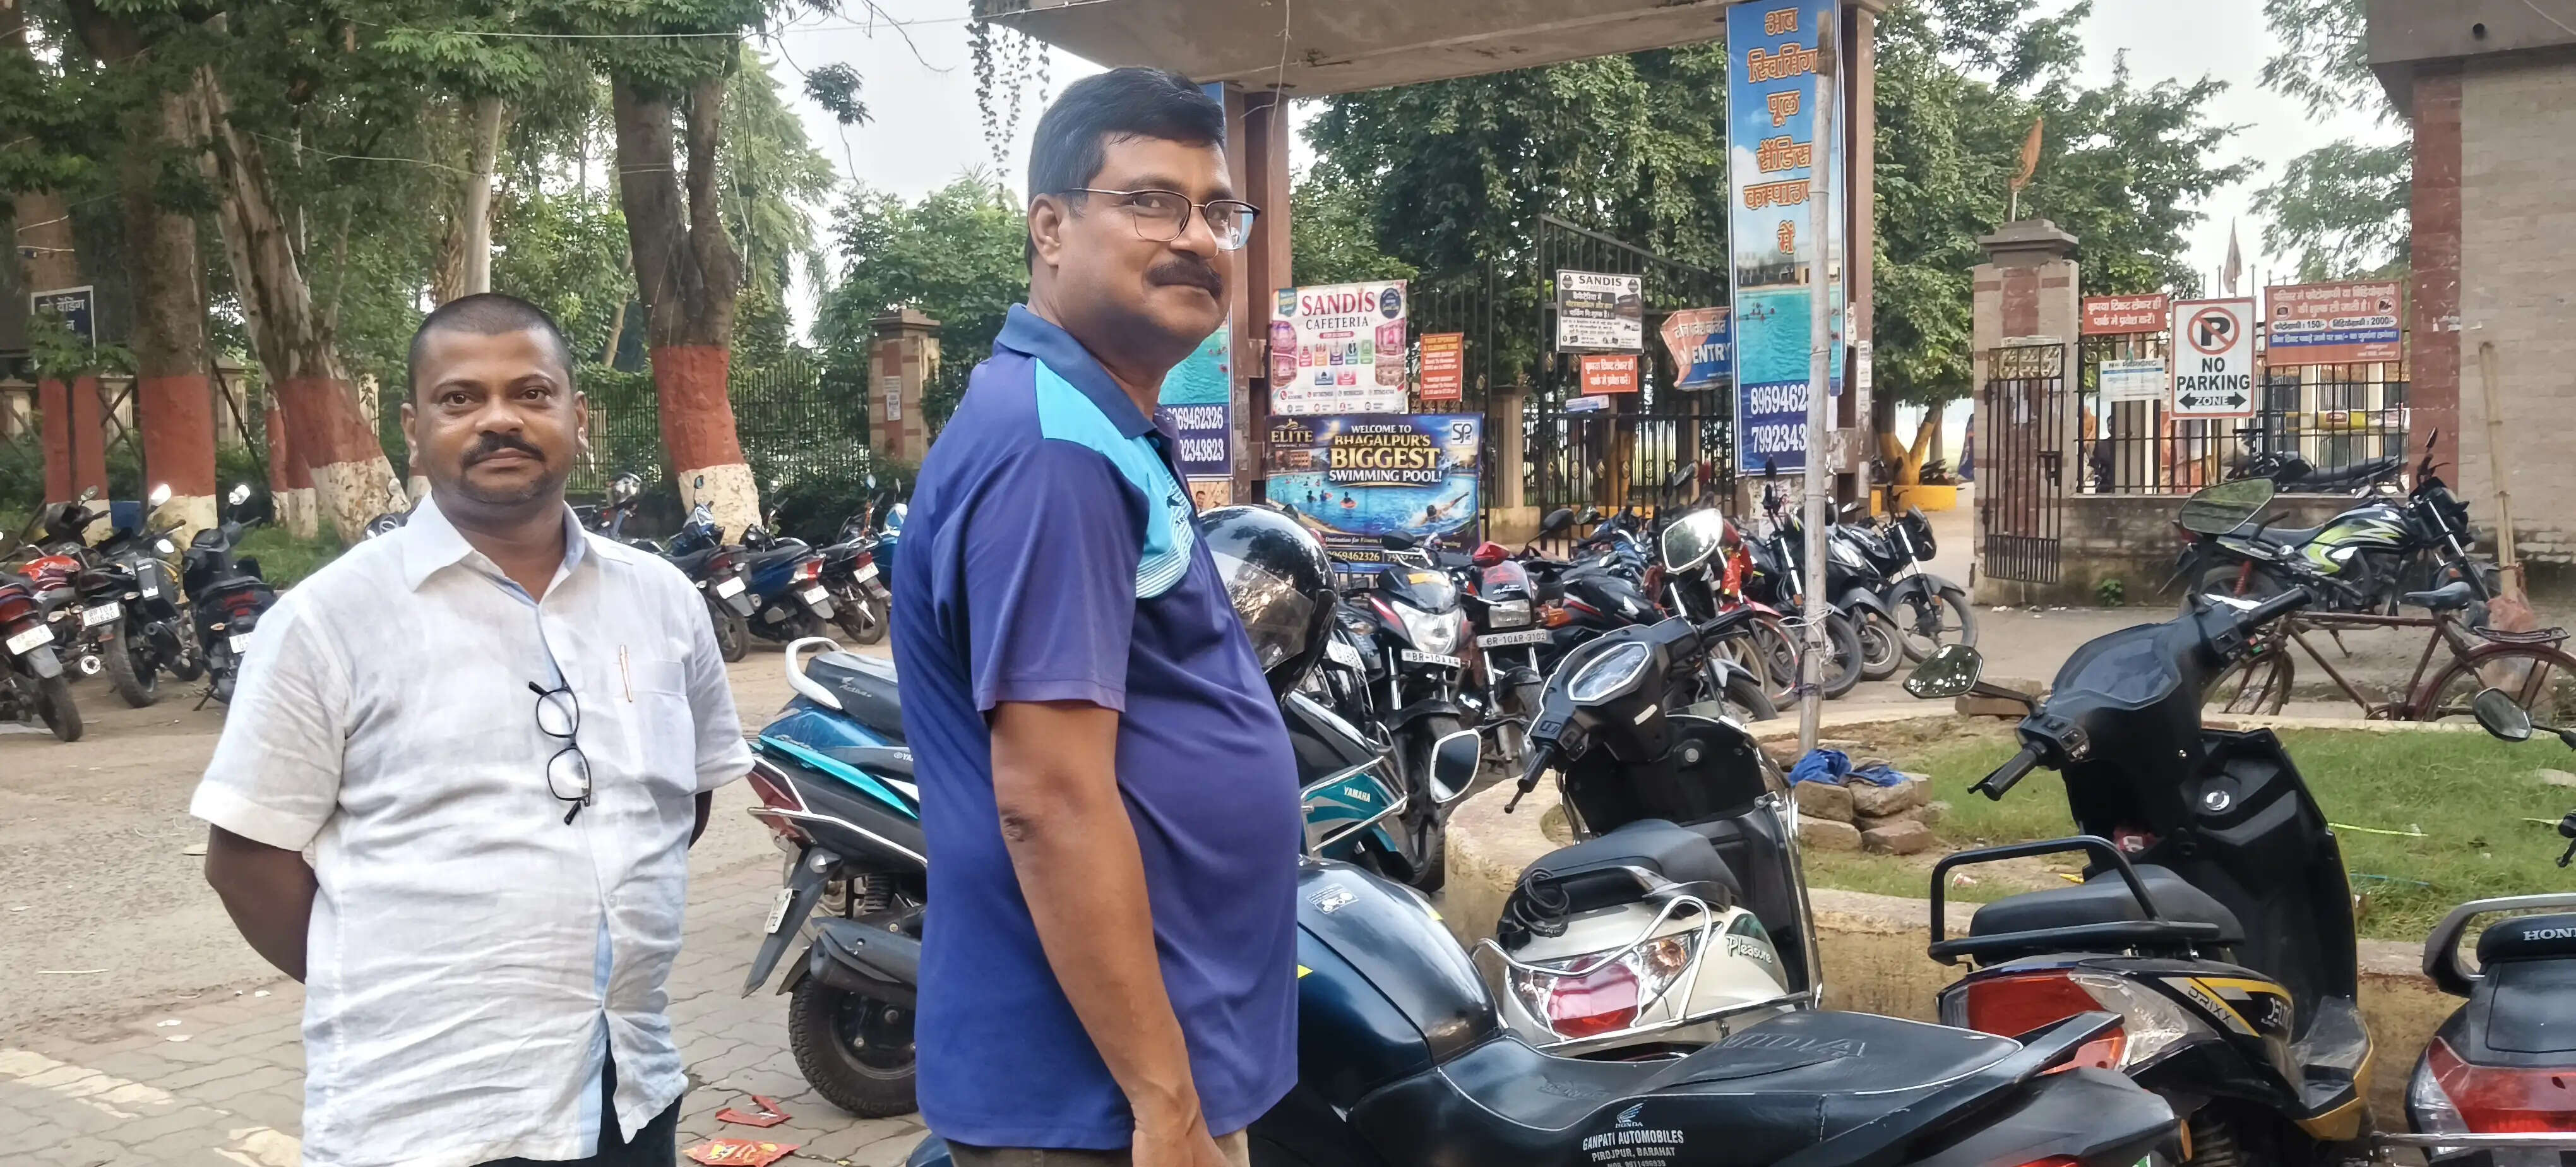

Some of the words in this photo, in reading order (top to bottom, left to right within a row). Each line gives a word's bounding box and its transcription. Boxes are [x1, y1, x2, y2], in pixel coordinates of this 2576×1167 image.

[1765, 8, 1798, 35] अब
[1767, 90, 1800, 126] पूल
[1778, 221, 1796, 253] में
[1579, 275, 1621, 286] SANDIS
[1302, 292, 1375, 316] SANDIS
[1306, 316, 1369, 330] CAFETERIA
[1692, 343, 1731, 364] ENTRY
[2202, 357, 2225, 373] NO
[2176, 374, 2250, 391] PARKING
[1751, 384, 1810, 415] 8969462
[2195, 396, 2229, 406] ZONE
[1271, 430, 1313, 442] ELITE
[1399, 424, 1412, 433] TO
[1335, 434, 1431, 447] BHAGALPUR'S
[1330, 447, 1440, 469] BIGGEST
[1328, 470, 1400, 482] SWIMMING
[1402, 469, 1442, 482] POOL!
[1344, 784, 1371, 803] YAMAHA
[2522, 927, 2576, 941] HON
[1725, 935, 1773, 964] Pleasure
[1582, 1132, 1616, 1151] GANPATI
[1618, 1130, 1685, 1145] AUTOMOBILES
[1592, 1147, 1635, 1162] PIROJPUR,
[1637, 1146, 1675, 1157] BARAHAT
